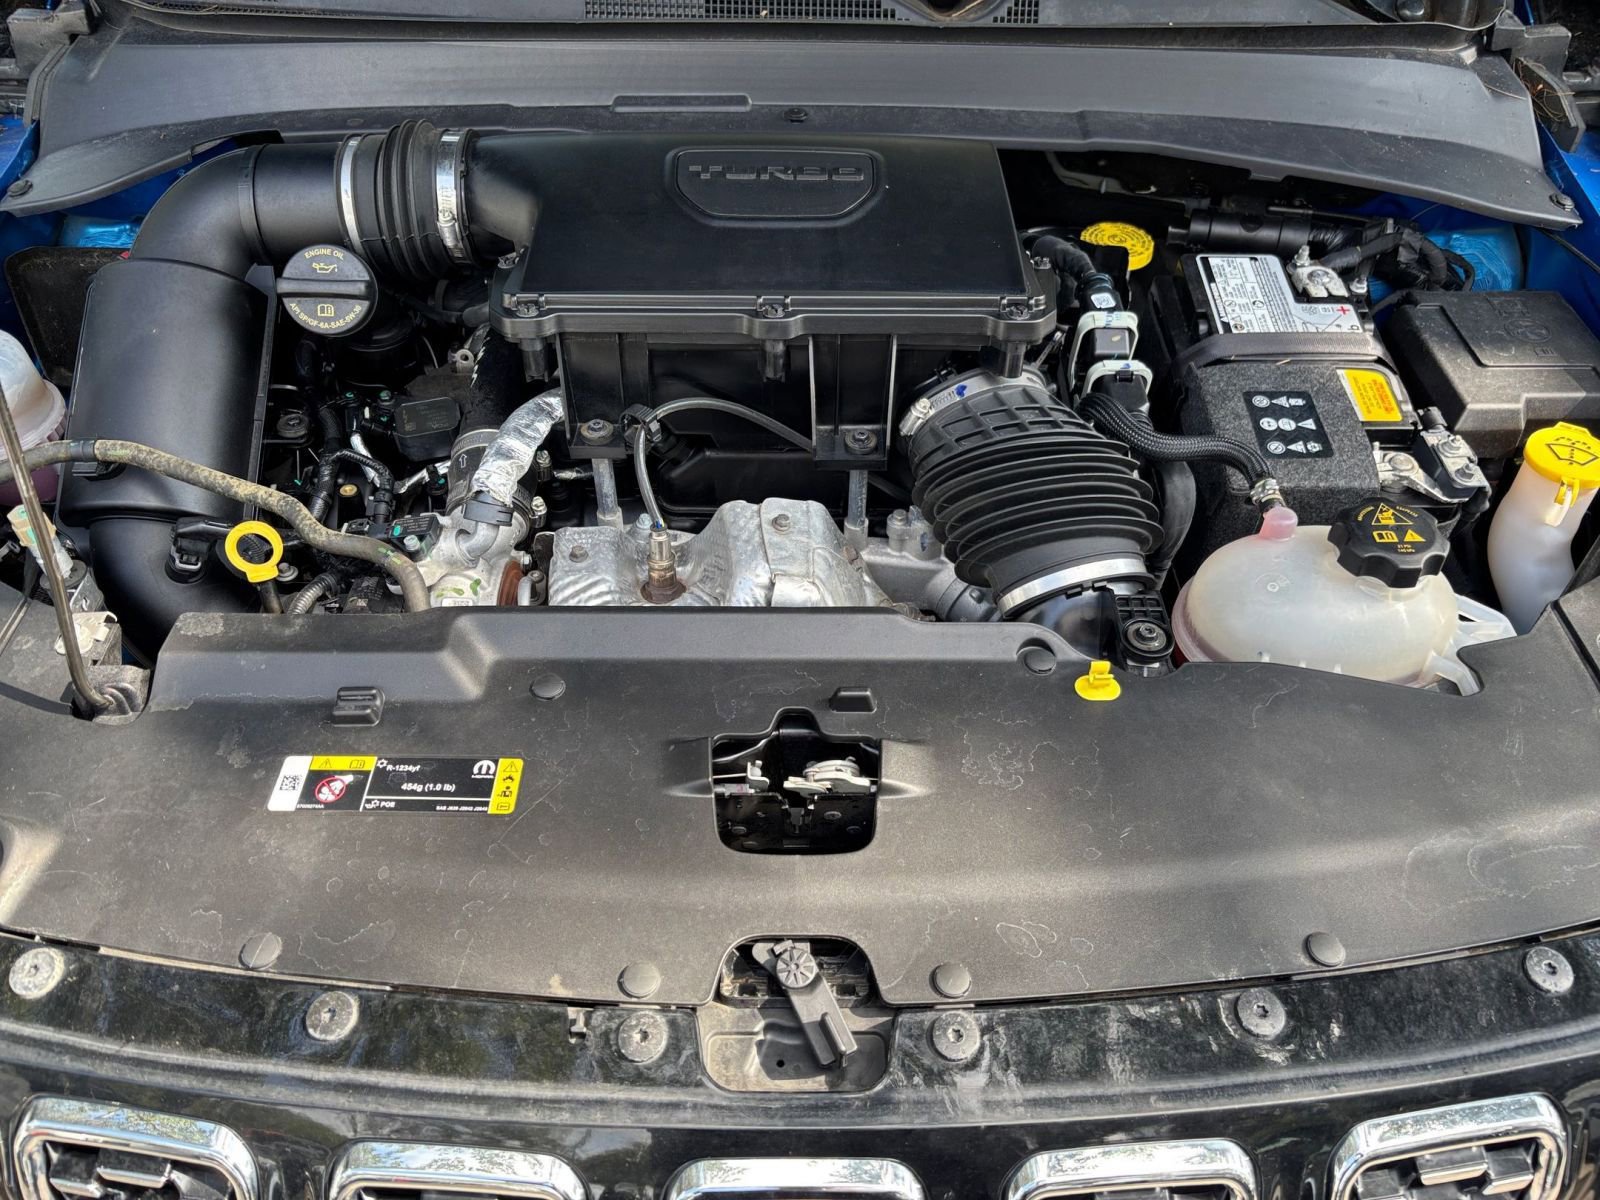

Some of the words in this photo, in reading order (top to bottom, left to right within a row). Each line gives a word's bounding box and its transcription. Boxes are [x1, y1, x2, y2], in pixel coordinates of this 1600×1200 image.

[687, 164, 866, 182] TURBO
[304, 248, 332, 259] ENGINE
[332, 250, 345, 261] OIL
[289, 303, 301, 315] API
[386, 764, 421, 772] R-1234yf
[401, 783, 423, 792] 454g
[424, 783, 442, 792] (1.0
[443, 784, 456, 792] lb)
